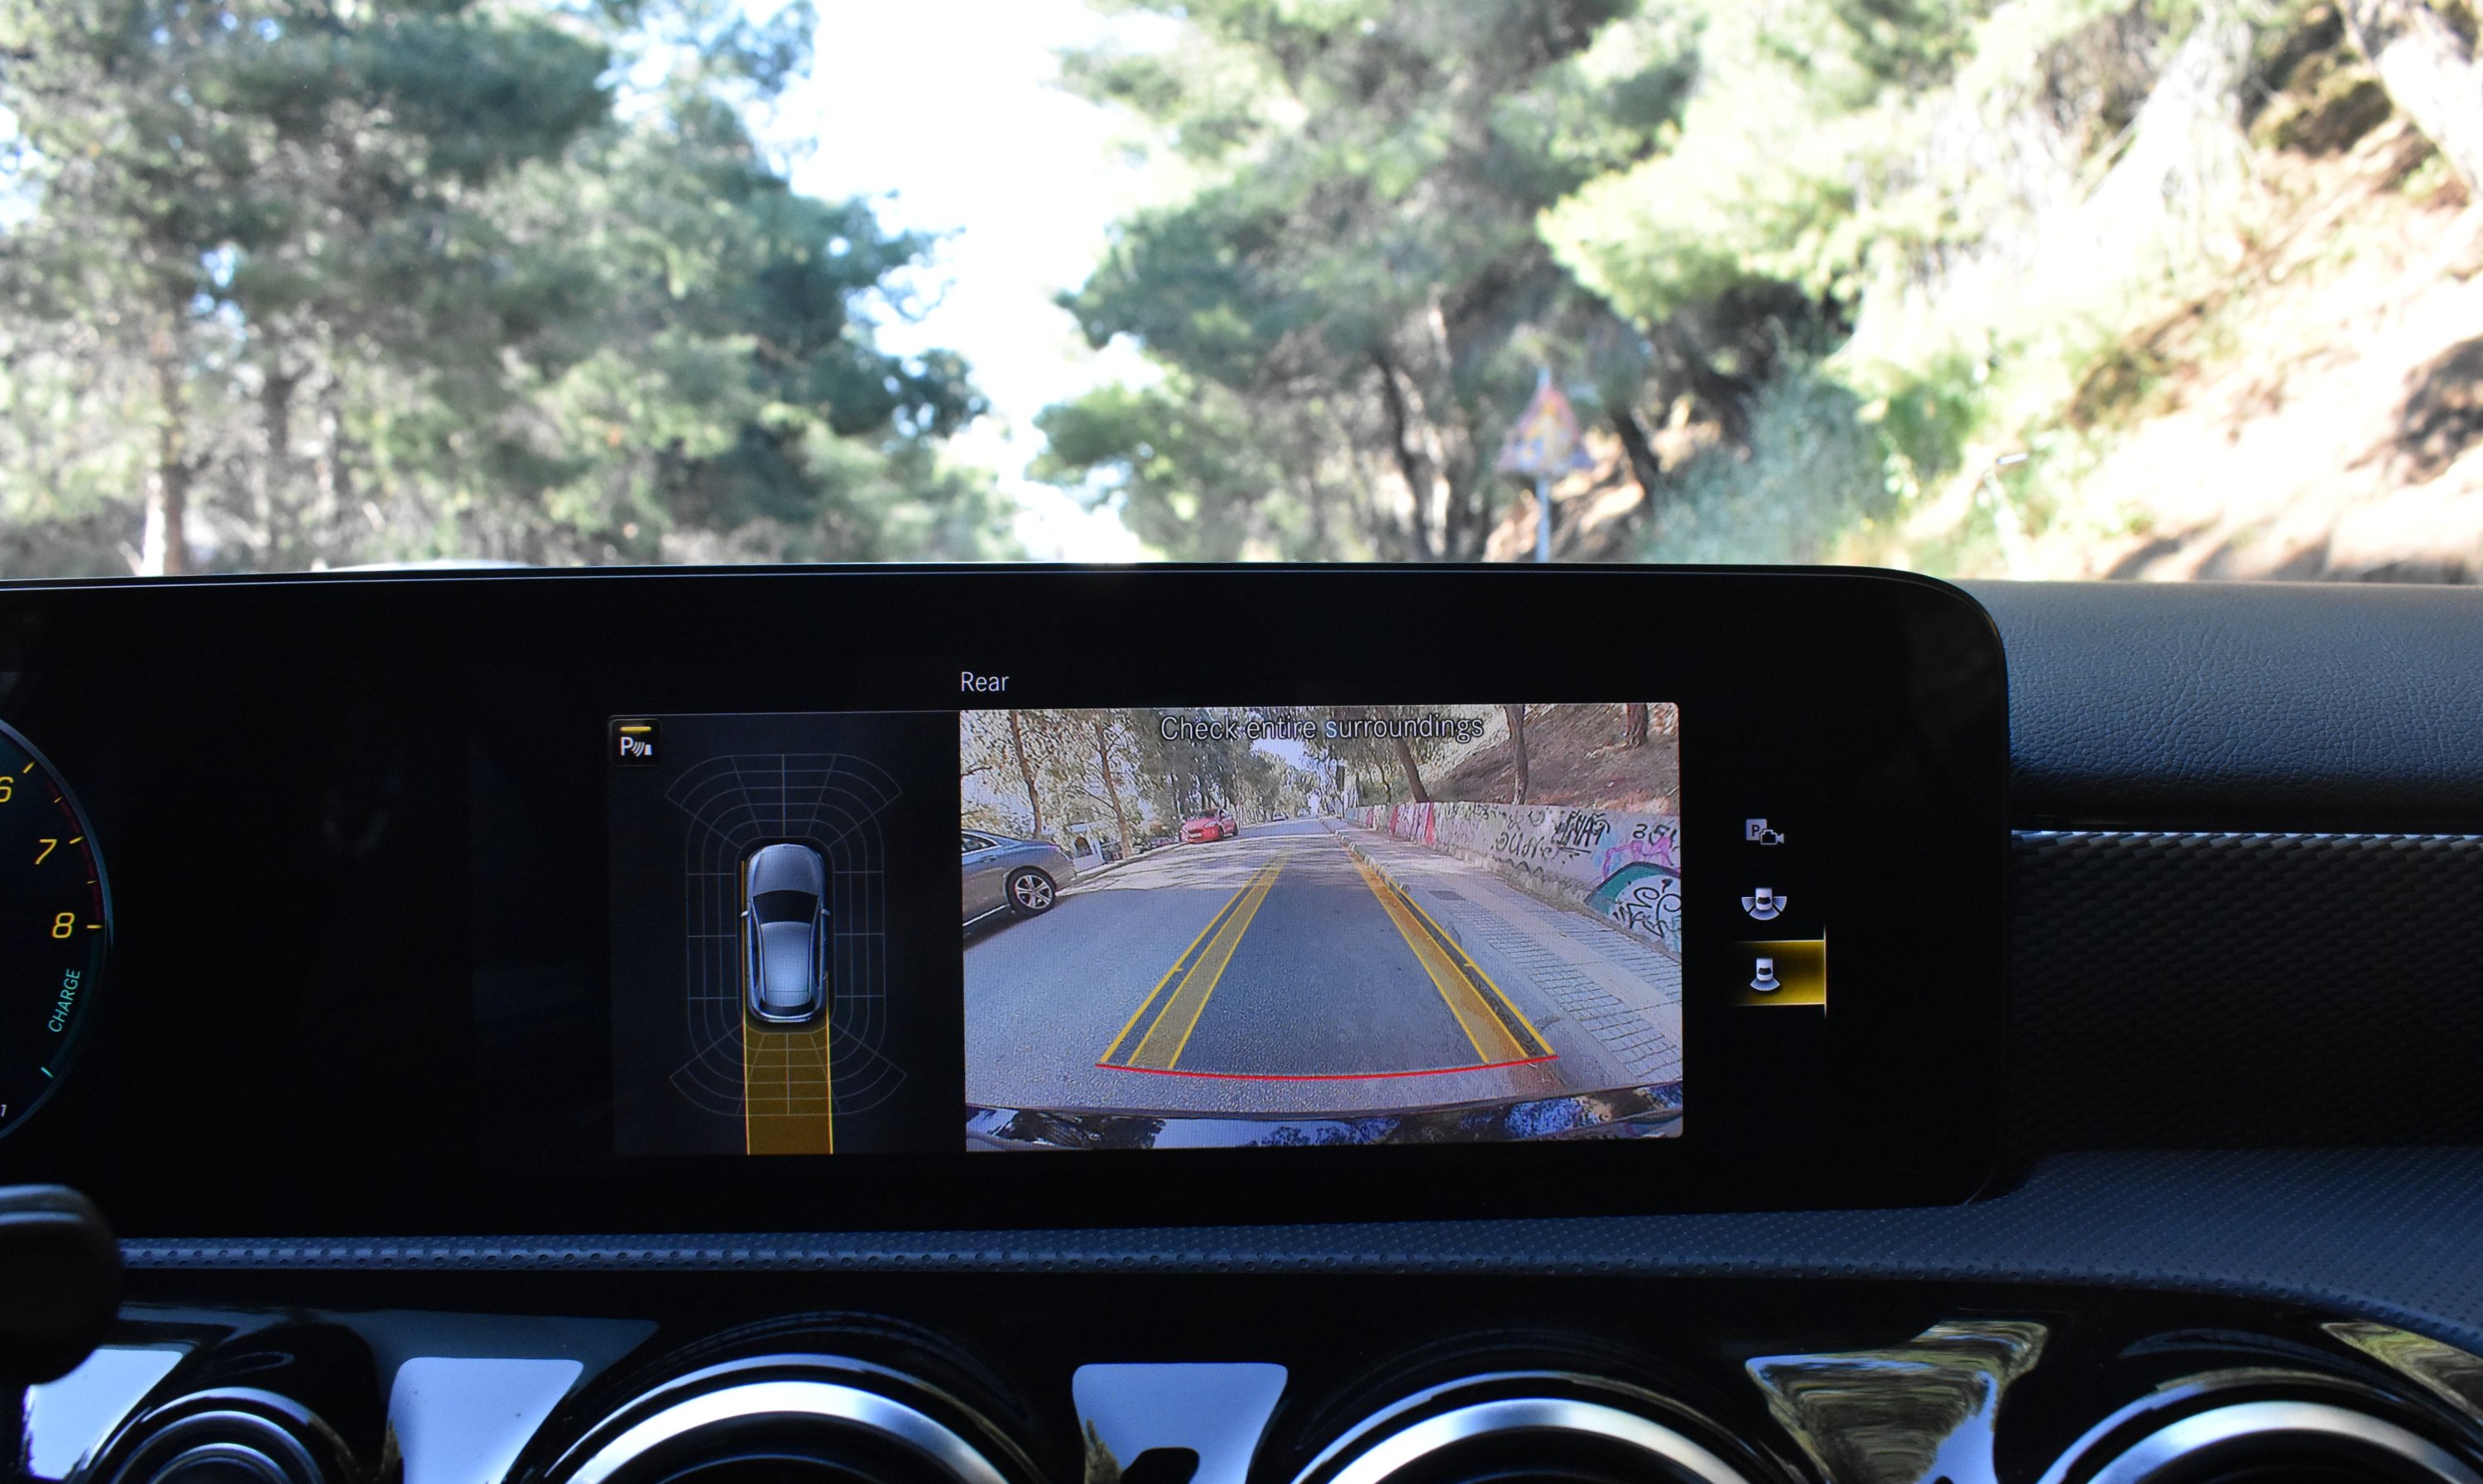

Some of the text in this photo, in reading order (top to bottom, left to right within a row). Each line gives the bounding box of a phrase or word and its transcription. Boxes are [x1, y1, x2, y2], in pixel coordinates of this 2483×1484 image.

[960, 670, 1010, 694] Rear
[1160, 712, 1484, 742] Check entire surroundings
[0, 776, 14, 803] 6
[1751, 824, 1760, 837] P
[35, 838, 58, 865] 7
[52, 911, 75, 939] 8
[48, 968, 81, 1034] CHARGE
